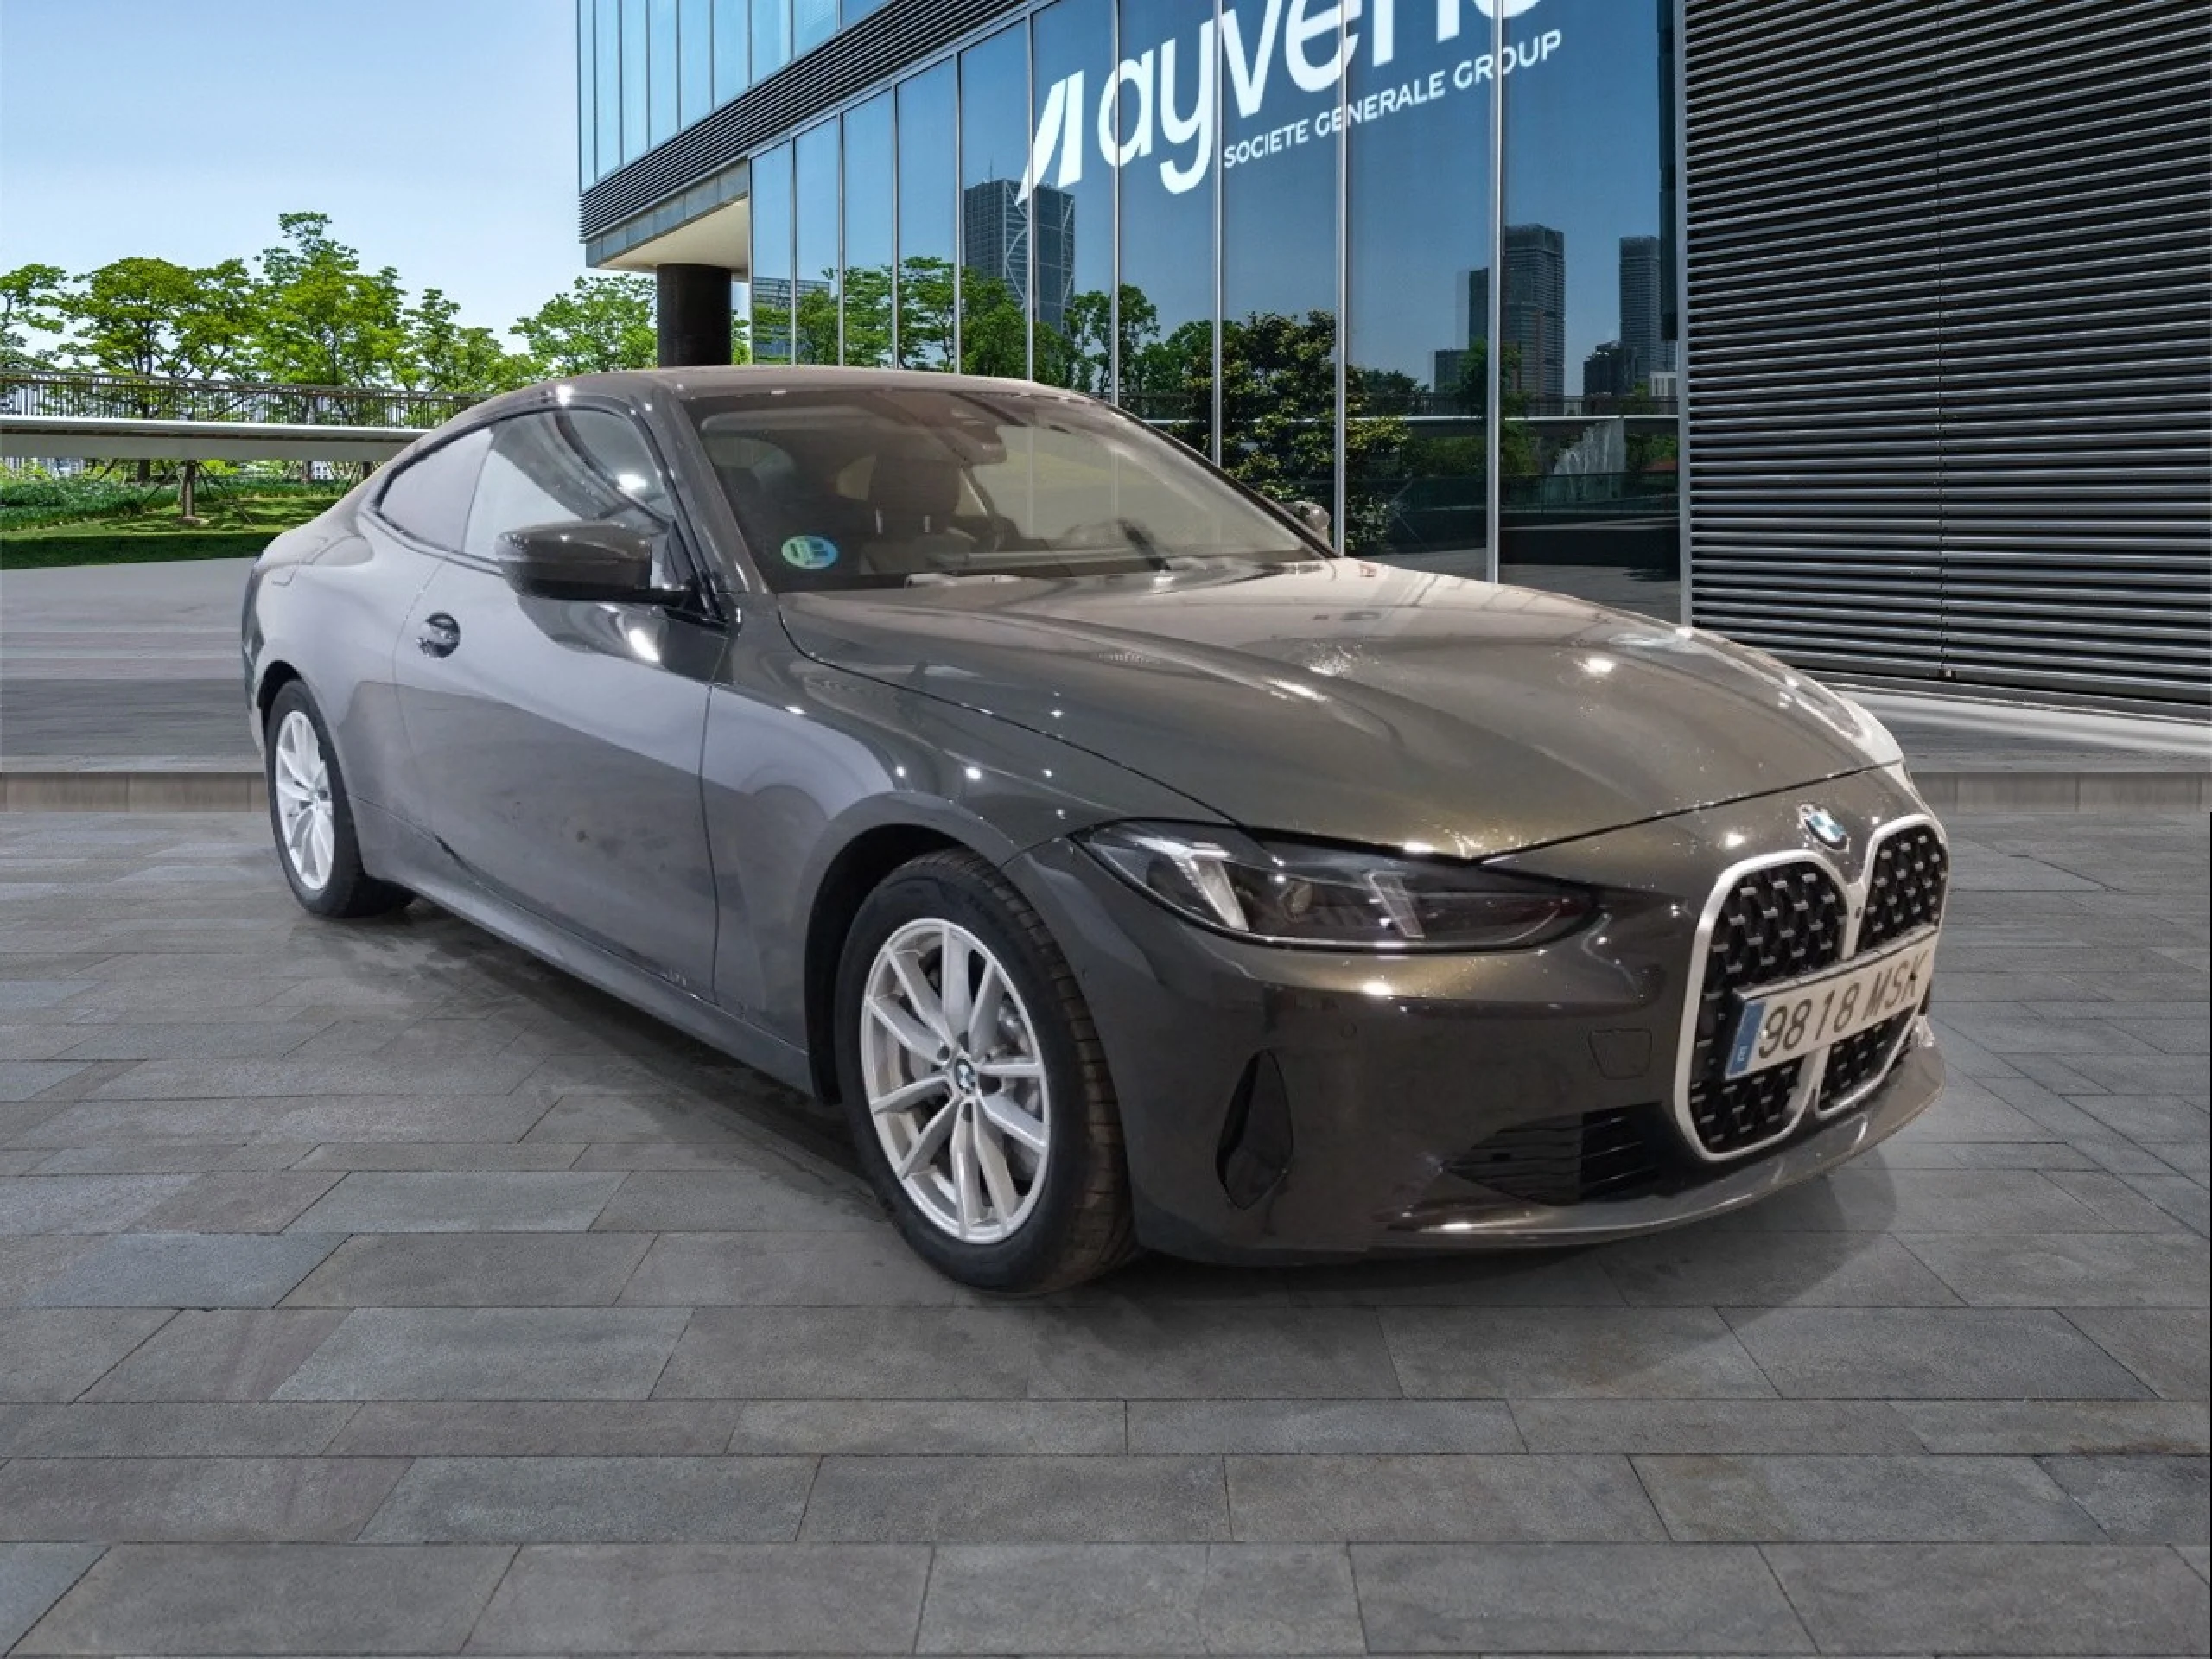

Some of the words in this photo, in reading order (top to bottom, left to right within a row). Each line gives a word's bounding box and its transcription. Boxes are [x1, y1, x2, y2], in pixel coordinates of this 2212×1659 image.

[1097, 0, 1541, 194] ayve
[1224, 118, 1310, 168] SOCIETE
[1314, 70, 1446, 137] GENERALE
[1453, 29, 1562, 90] GROUP
[1758, 982, 1860, 1058] 9818
[1861, 950, 1929, 1021] MSK
